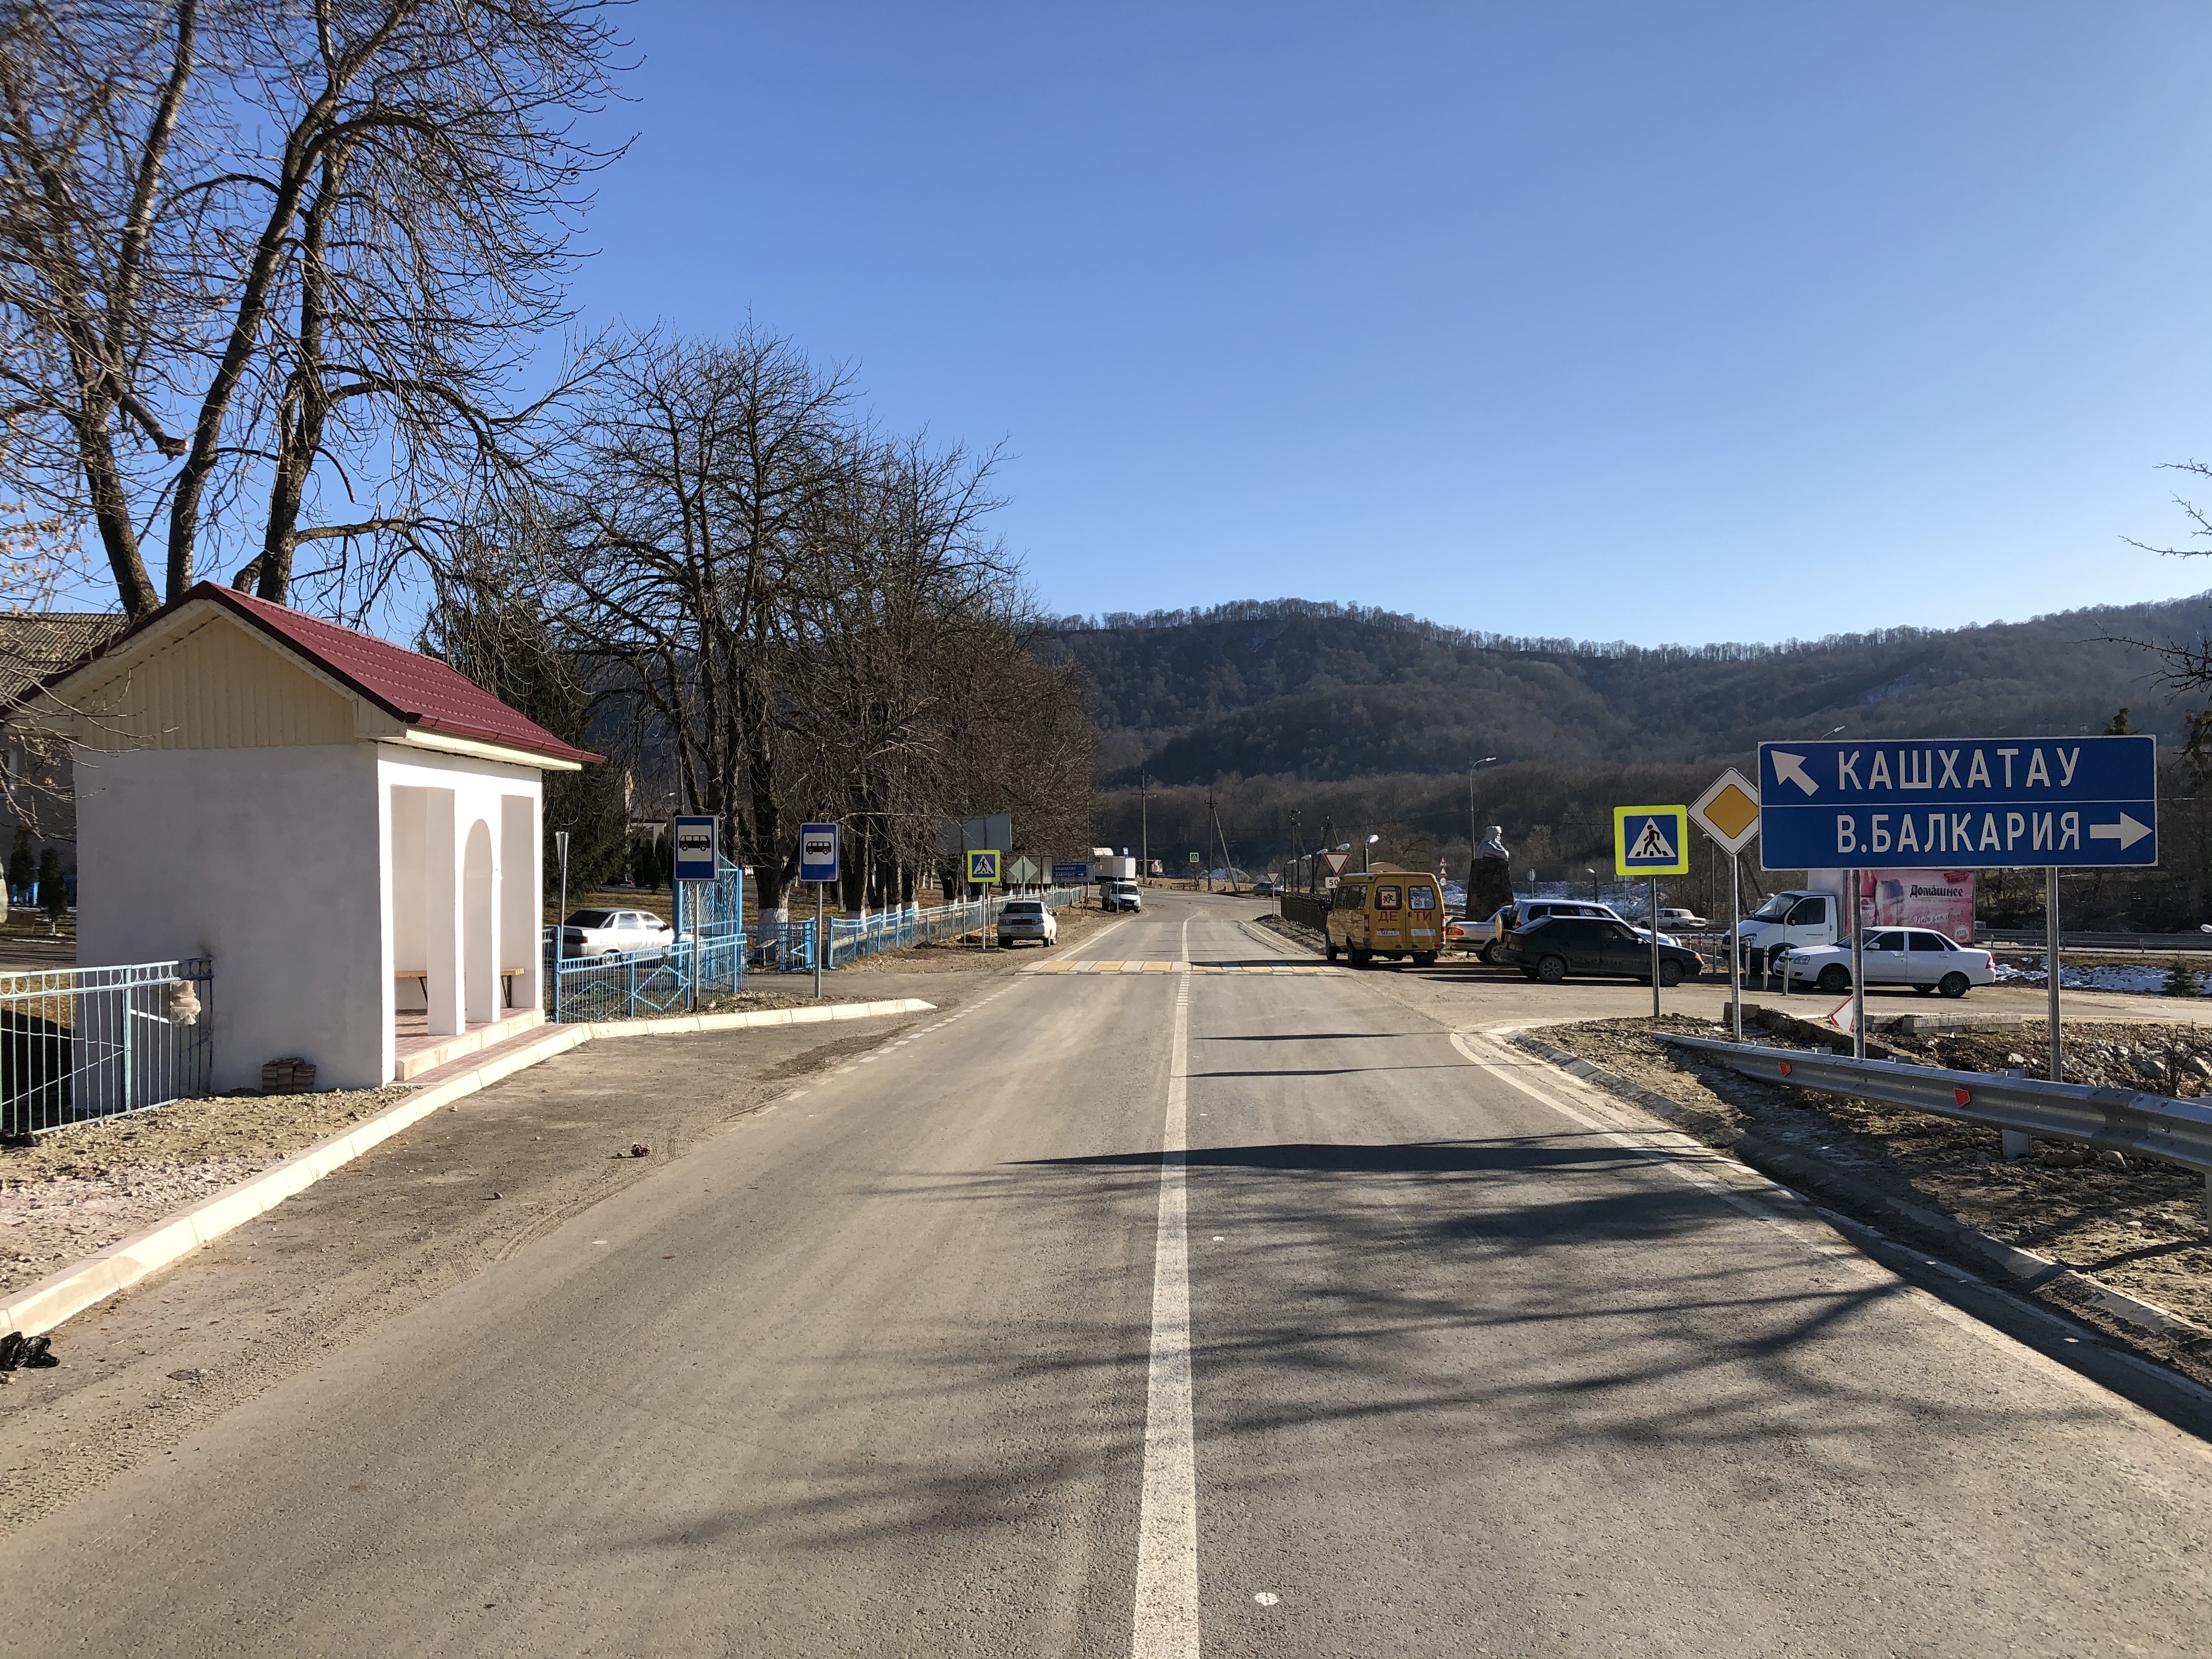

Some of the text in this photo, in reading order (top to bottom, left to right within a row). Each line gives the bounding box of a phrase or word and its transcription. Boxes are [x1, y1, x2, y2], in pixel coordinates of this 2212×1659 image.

[1838, 747, 2080, 790] КАШХАТАУ
[1837, 811, 2080, 853] В.БАЛКАРИЯ
[1910, 884, 1964, 898] Домашнее
